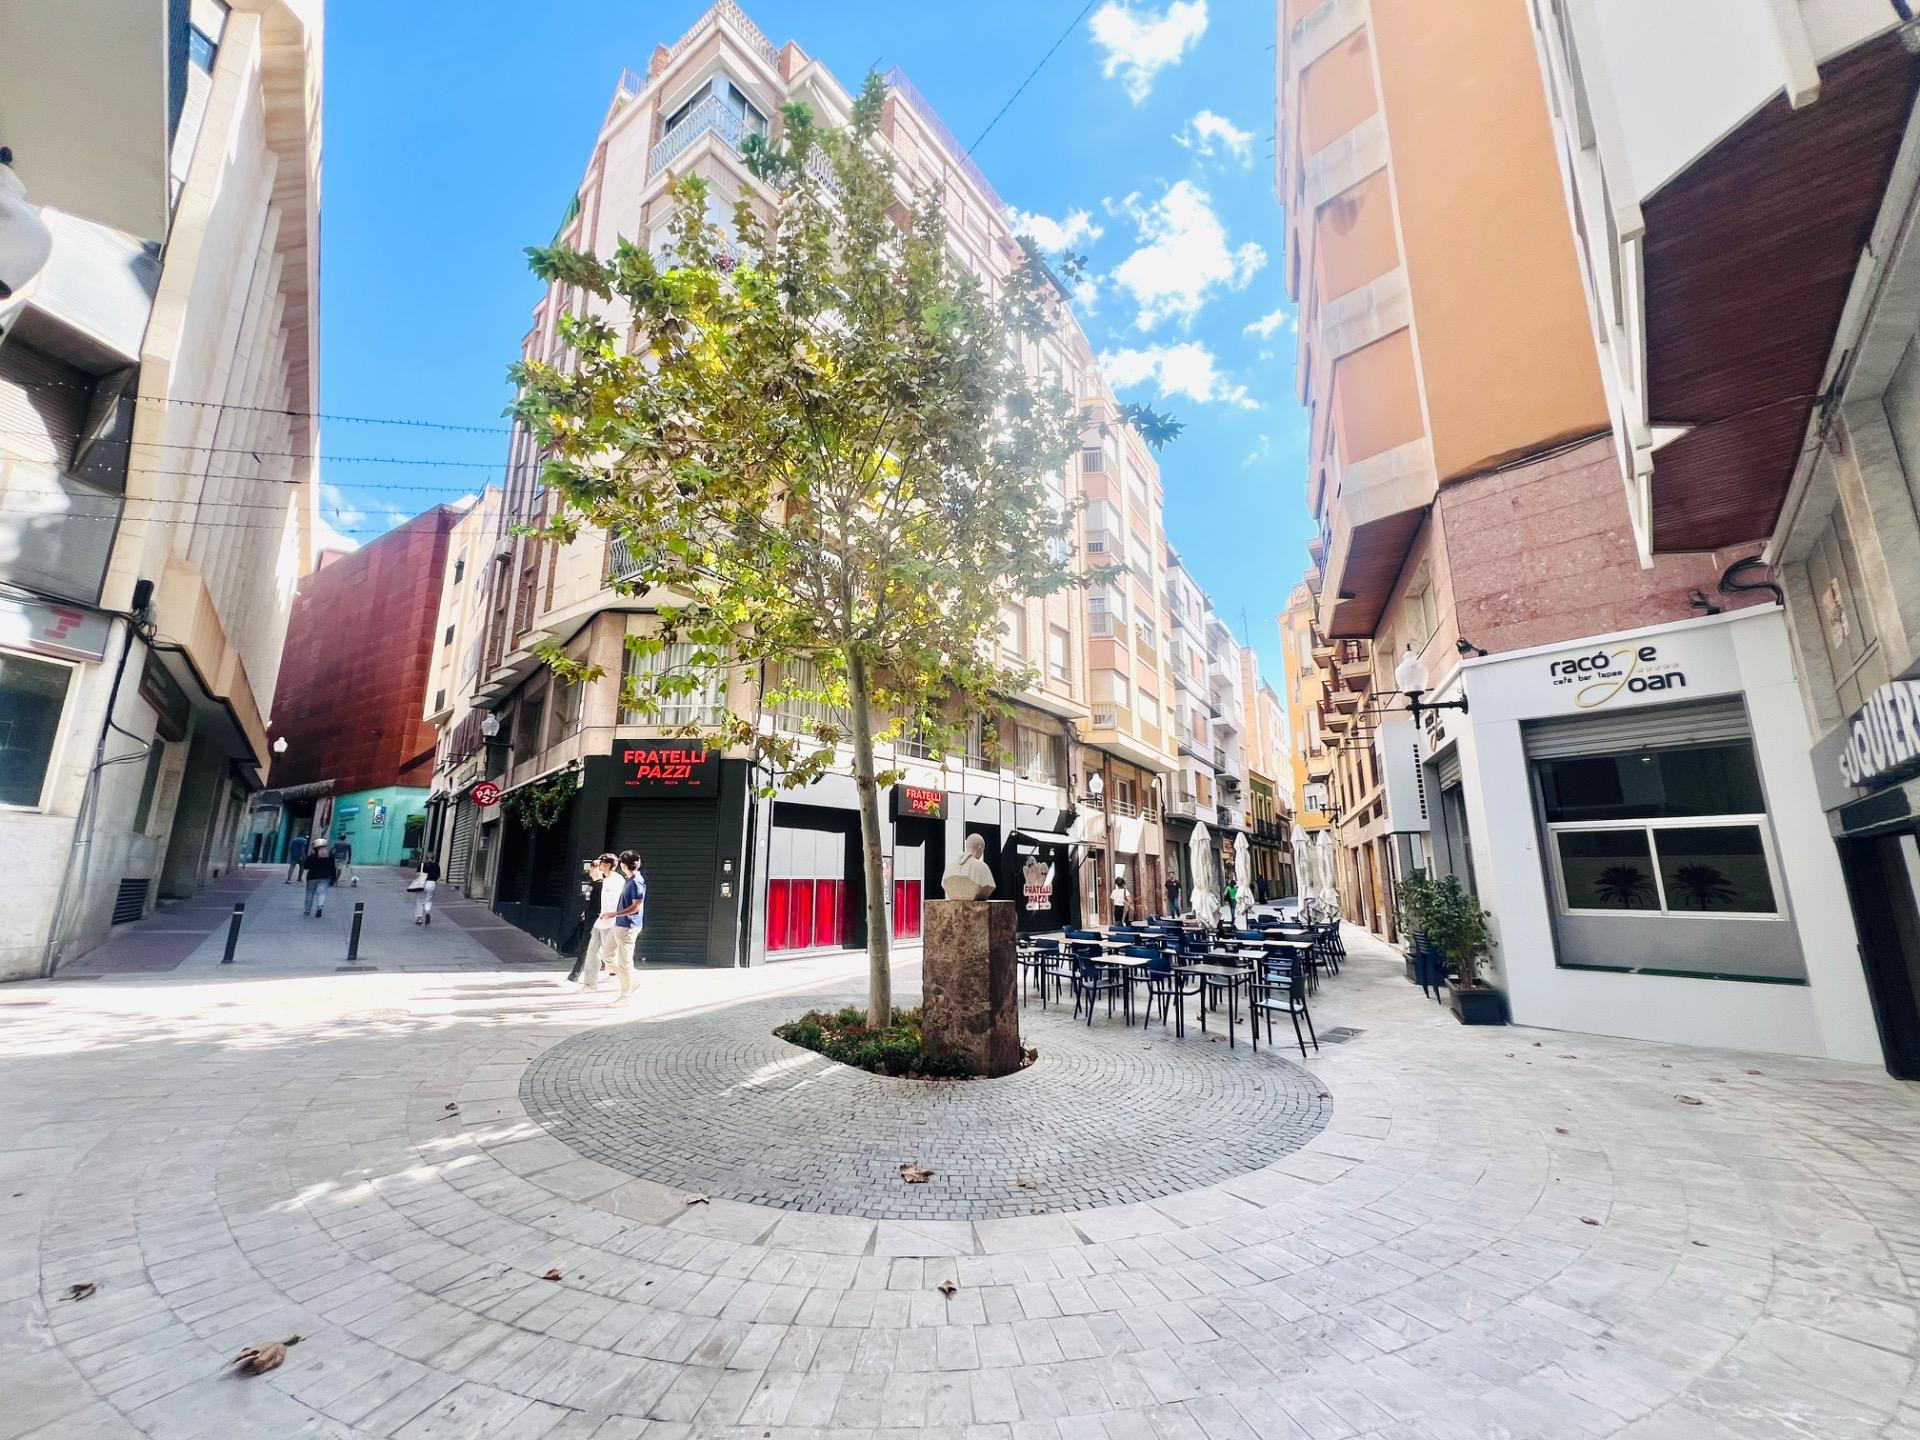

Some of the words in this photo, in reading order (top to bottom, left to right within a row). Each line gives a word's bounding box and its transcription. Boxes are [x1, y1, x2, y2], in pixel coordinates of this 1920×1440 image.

[1550, 651, 1609, 676] racó
[623, 750, 707, 764] FRATELLI
[637, 765, 691, 778] PAZZI
[906, 788, 941, 802] FRATELLI
[1024, 885, 1051, 894] FRATELLI
